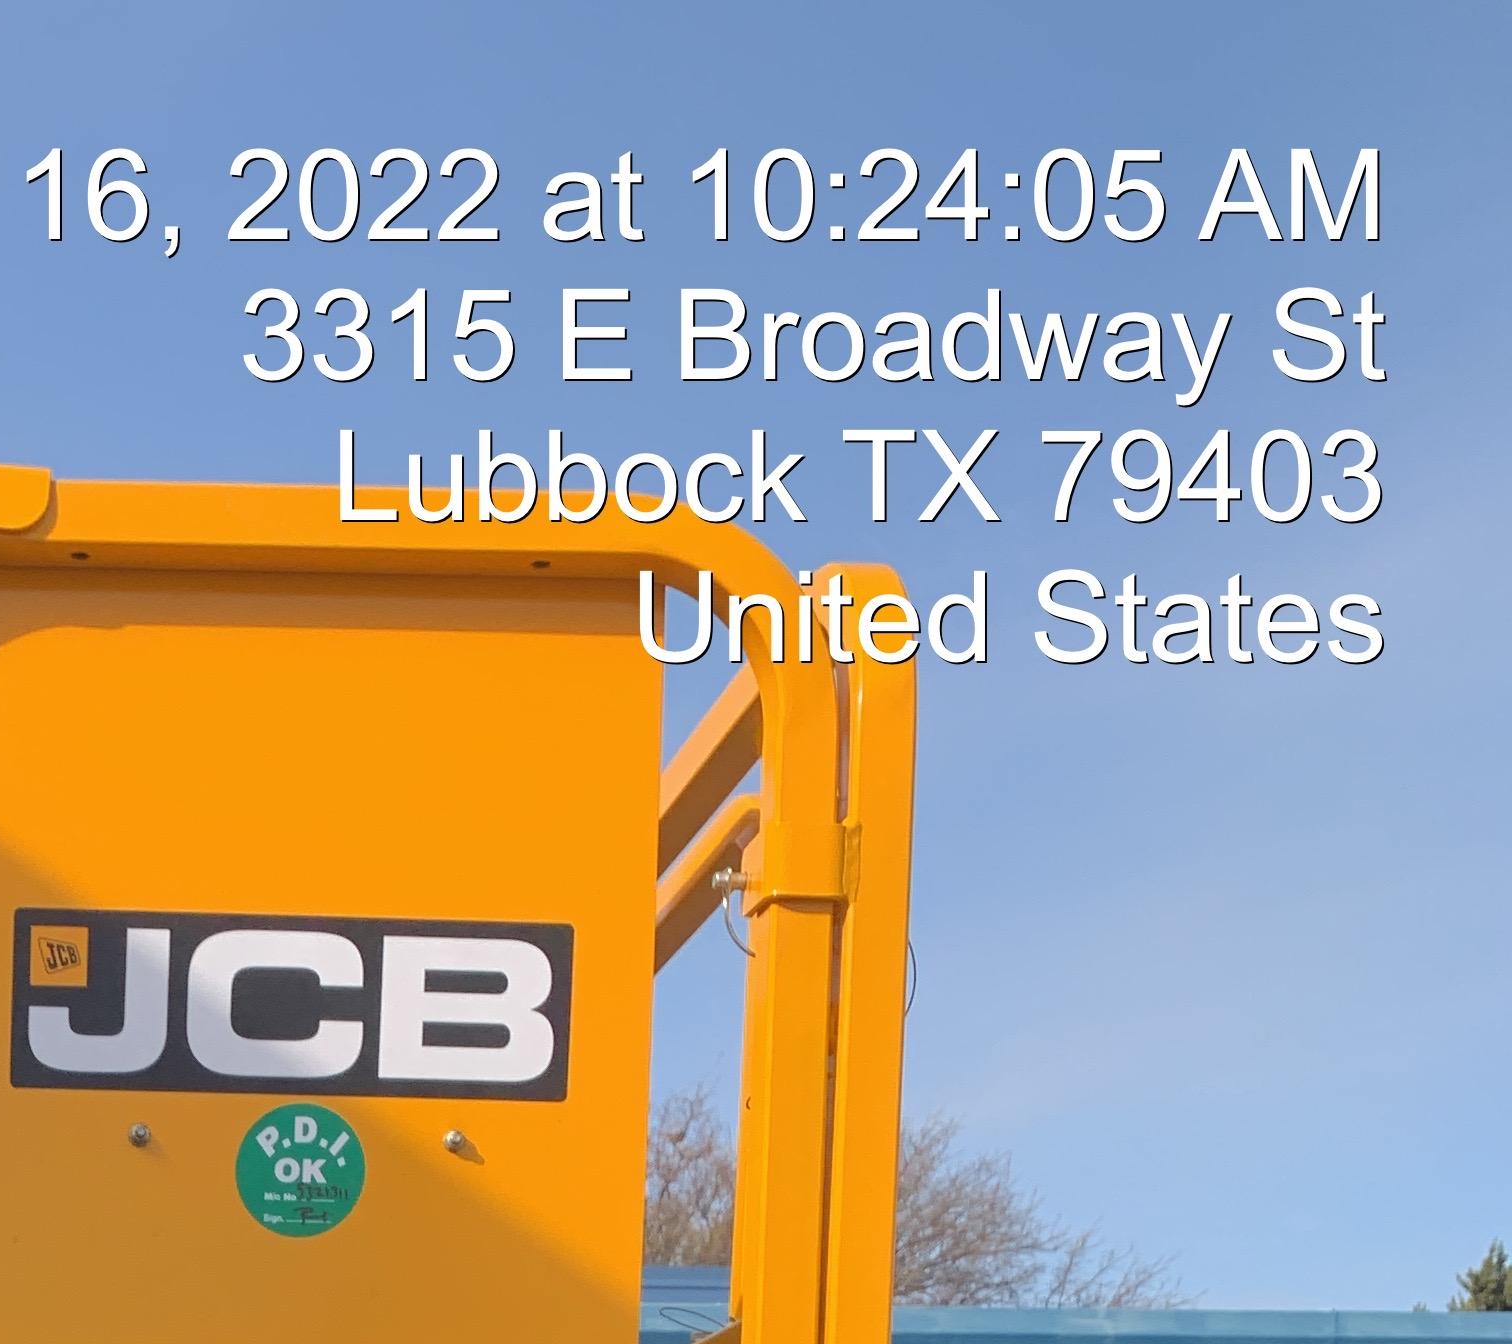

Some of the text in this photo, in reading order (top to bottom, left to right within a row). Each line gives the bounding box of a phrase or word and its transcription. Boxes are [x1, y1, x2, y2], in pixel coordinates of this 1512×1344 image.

[46, 941, 78, 970] JCB
[28, 927, 555, 1083] JCB
[274, 1157, 327, 1184] OK
